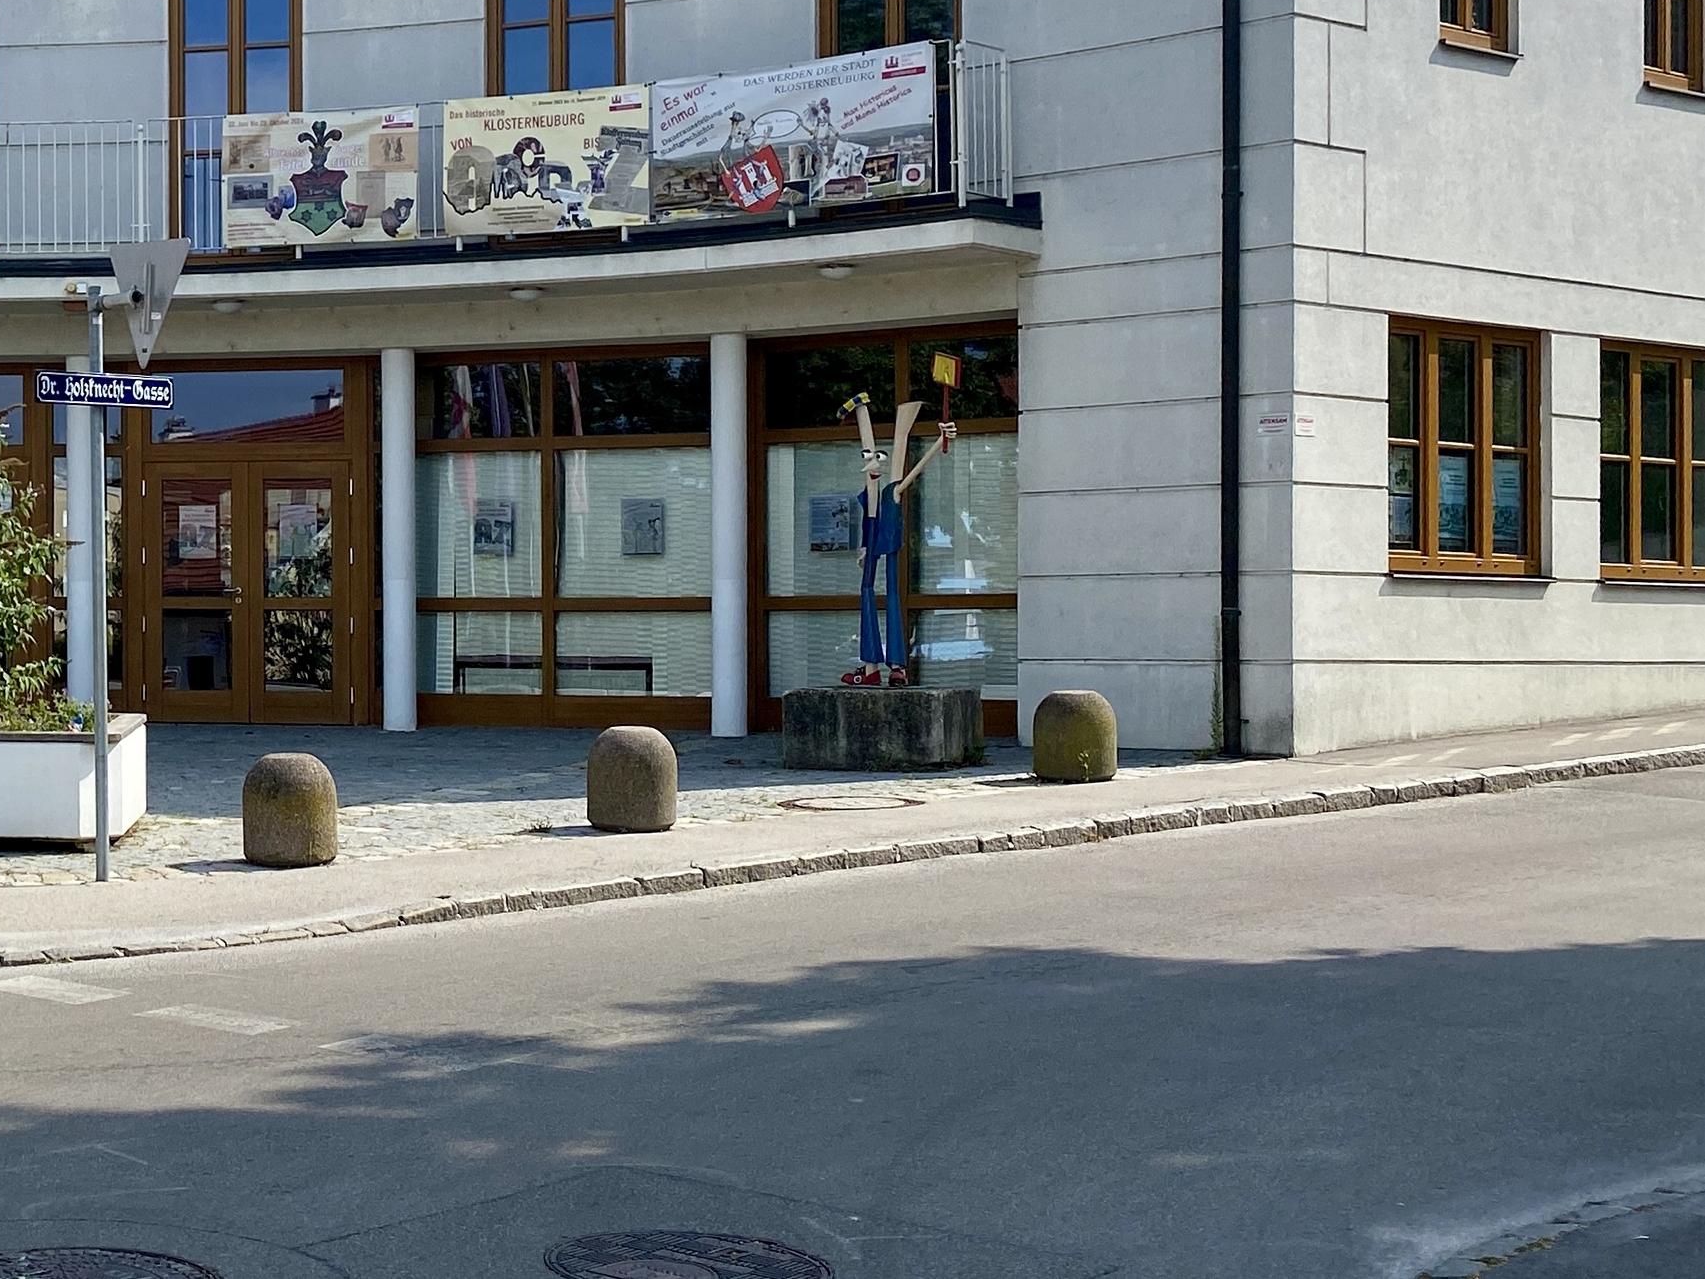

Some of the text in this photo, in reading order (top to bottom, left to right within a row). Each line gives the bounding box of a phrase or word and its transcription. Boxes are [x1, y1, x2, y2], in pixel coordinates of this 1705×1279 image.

[743, 76, 765, 88] DAS
[767, 69, 813, 84] WERDEN
[816, 64, 839, 76] DER
[841, 57, 876, 72] STADT
[683, 83, 707, 102] war
[774, 71, 875, 95] KLOSTERNEUBURG
[449, 108, 506, 120] Das historische
[483, 112, 586, 132] KLOSTERNEUBURG
[450, 137, 473, 151] VON
[583, 137, 601, 149] BIS
[40, 376, 60, 395] Dr.
